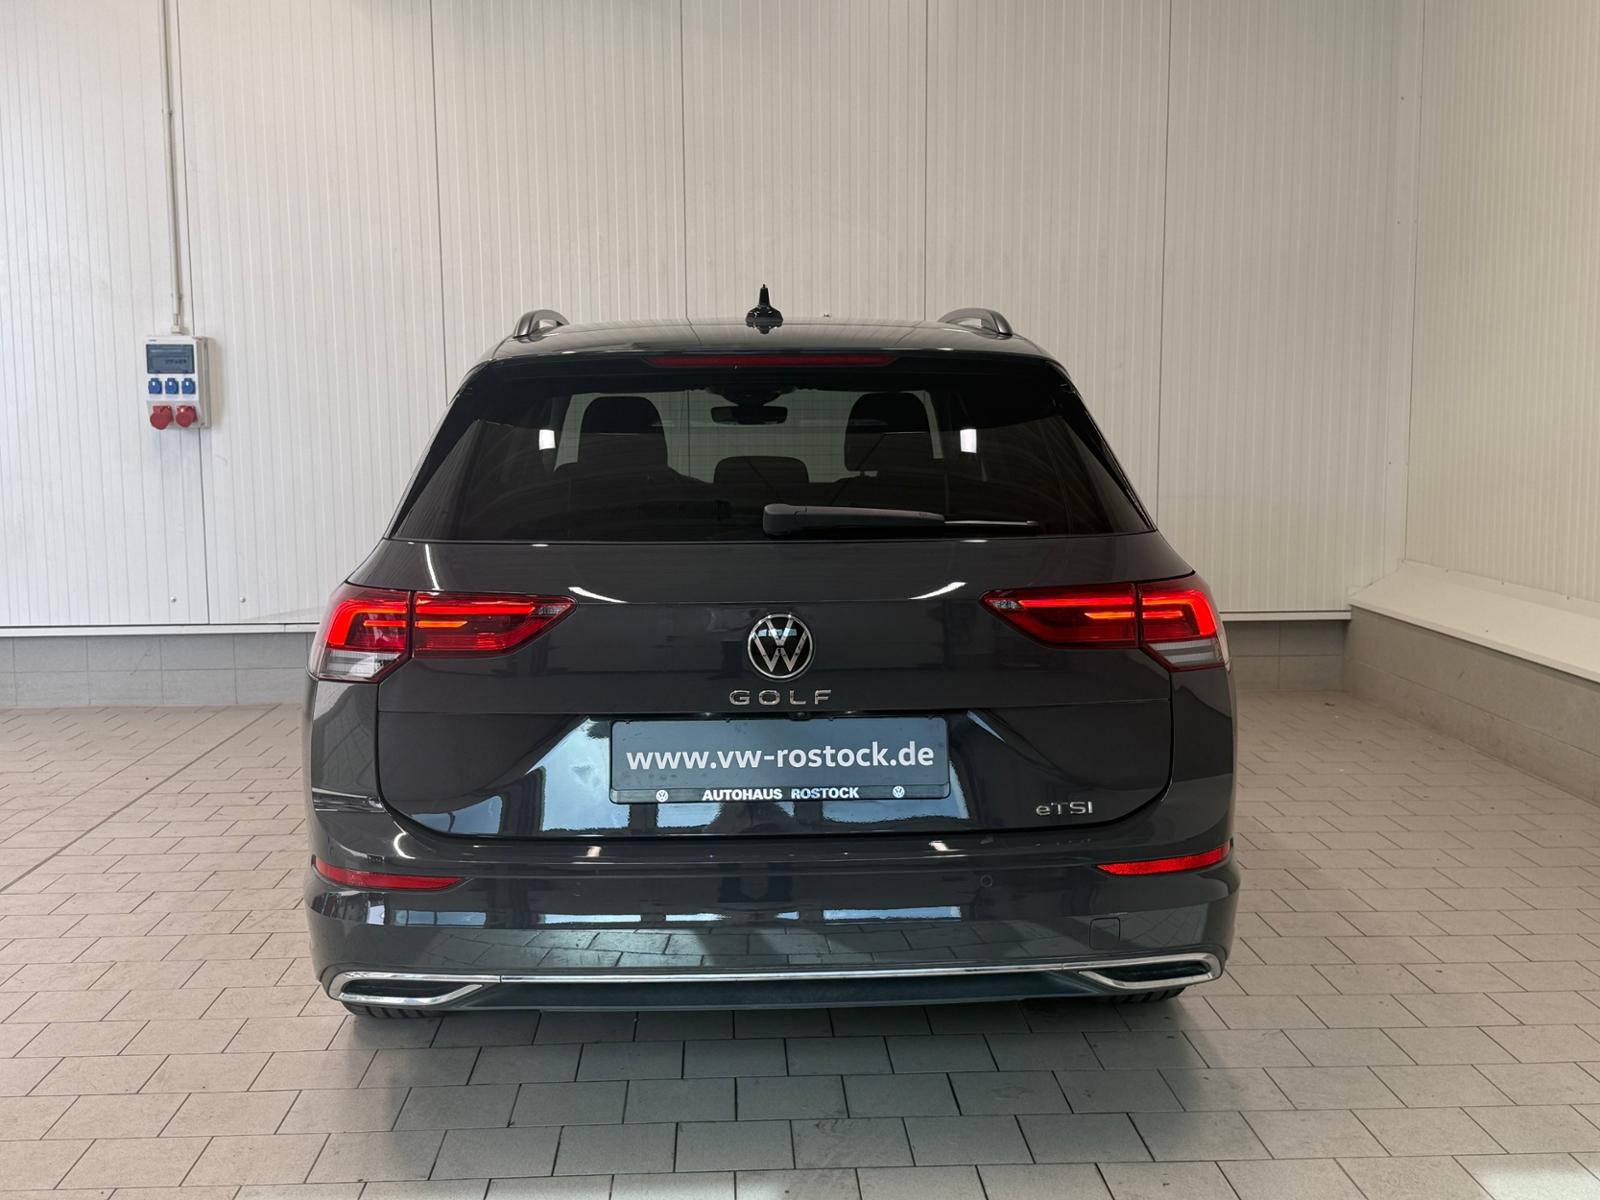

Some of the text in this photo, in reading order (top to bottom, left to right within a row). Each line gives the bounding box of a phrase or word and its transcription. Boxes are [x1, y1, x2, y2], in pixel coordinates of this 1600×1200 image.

[729, 689, 832, 705] GOLF
[626, 741, 935, 770] www.vw-rostock.de
[702, 786, 859, 801] AUTOHAUS ROSTOCK
[1036, 801, 1093, 816] eTSI
